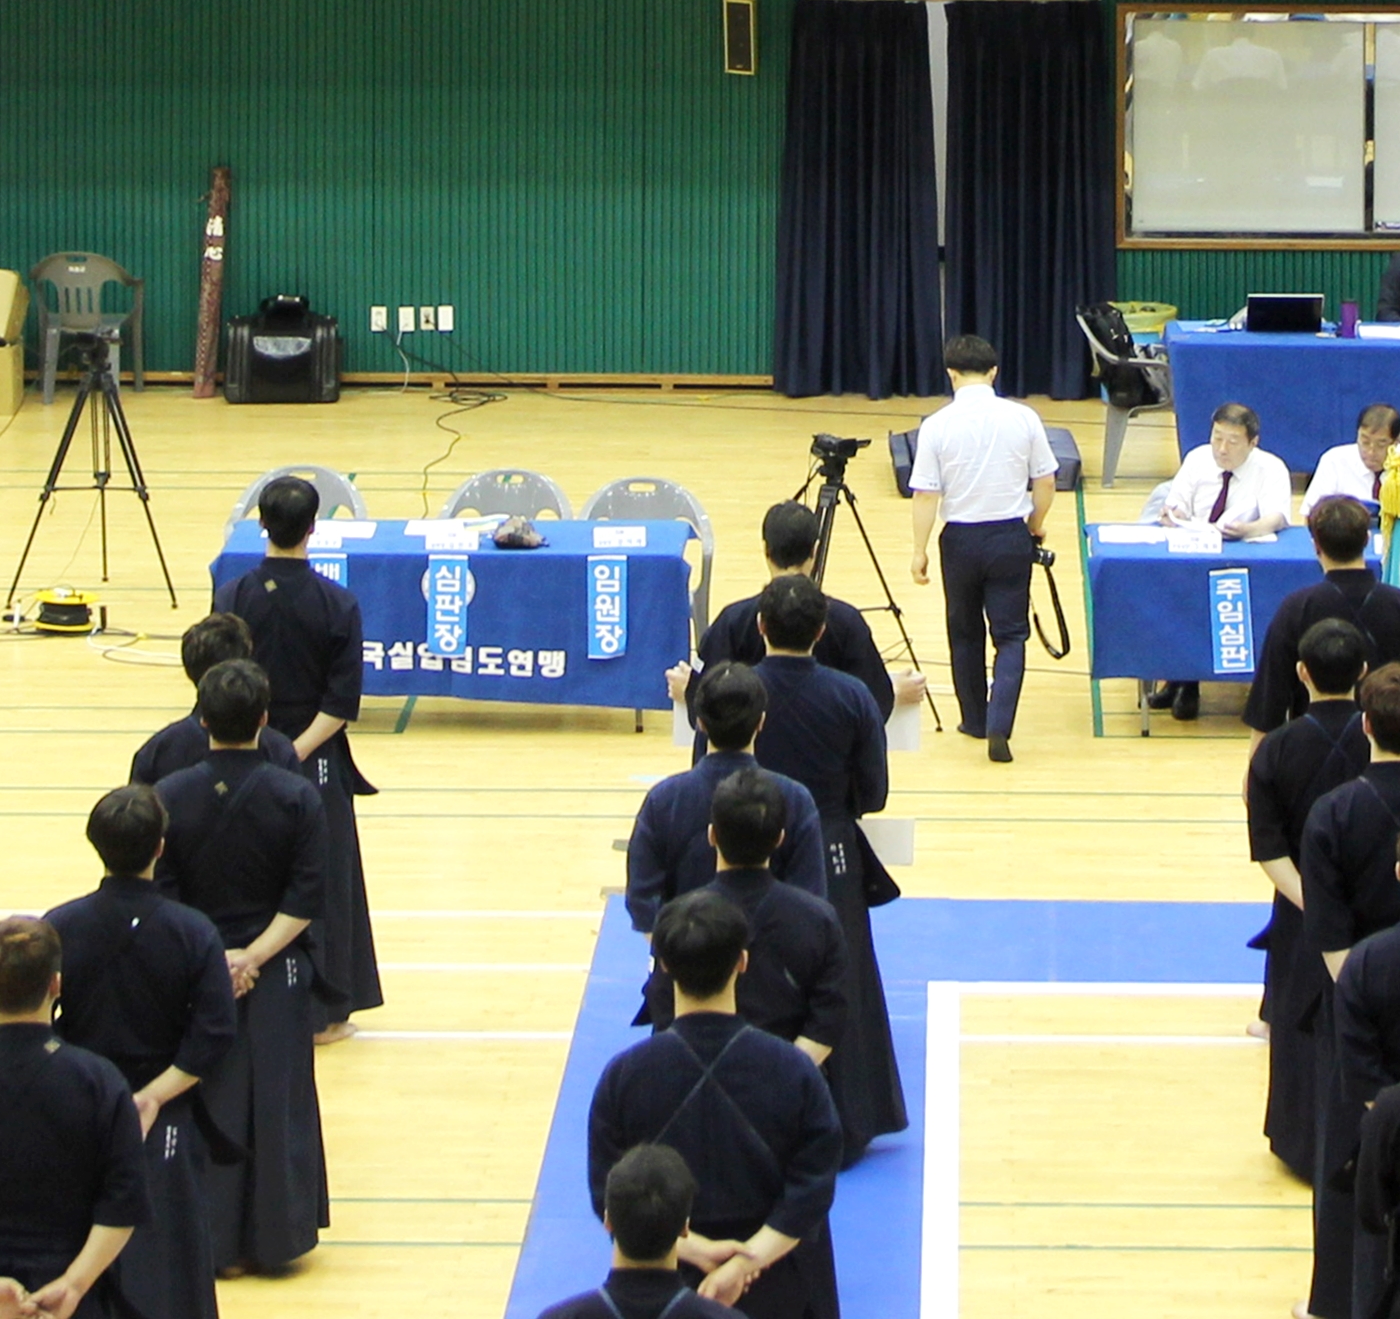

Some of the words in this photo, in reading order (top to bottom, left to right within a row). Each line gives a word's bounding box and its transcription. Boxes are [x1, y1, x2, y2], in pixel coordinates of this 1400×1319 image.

[434, 565, 463, 652] 심판장
[593, 564, 624, 653] 임원장
[1215, 578, 1250, 669] 주임심판
